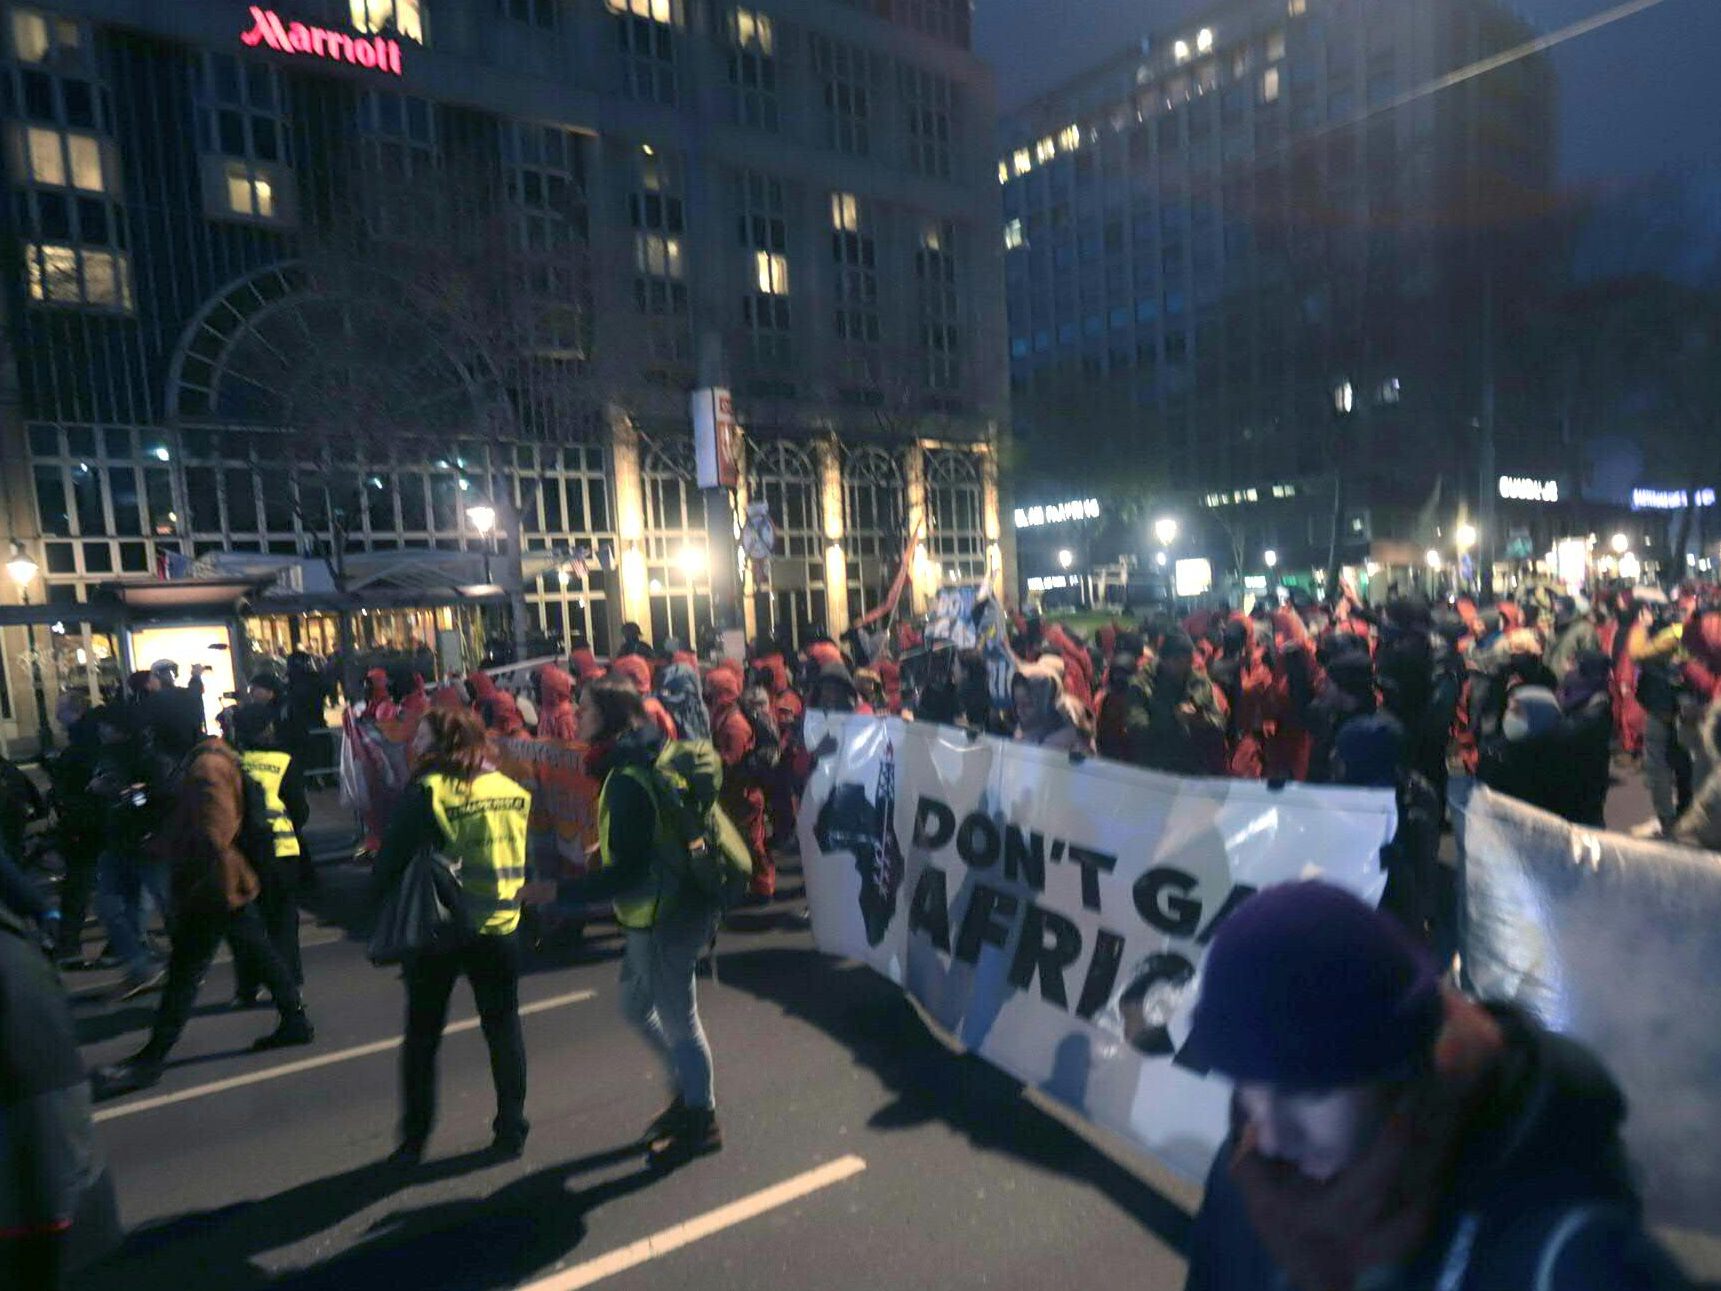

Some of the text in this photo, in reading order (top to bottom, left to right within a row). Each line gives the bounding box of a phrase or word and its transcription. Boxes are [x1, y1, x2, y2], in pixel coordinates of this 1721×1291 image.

[240, 5, 402, 76] Marriott
[912, 796, 1118, 911] DON'T
[908, 865, 1208, 1075] AFRIC
